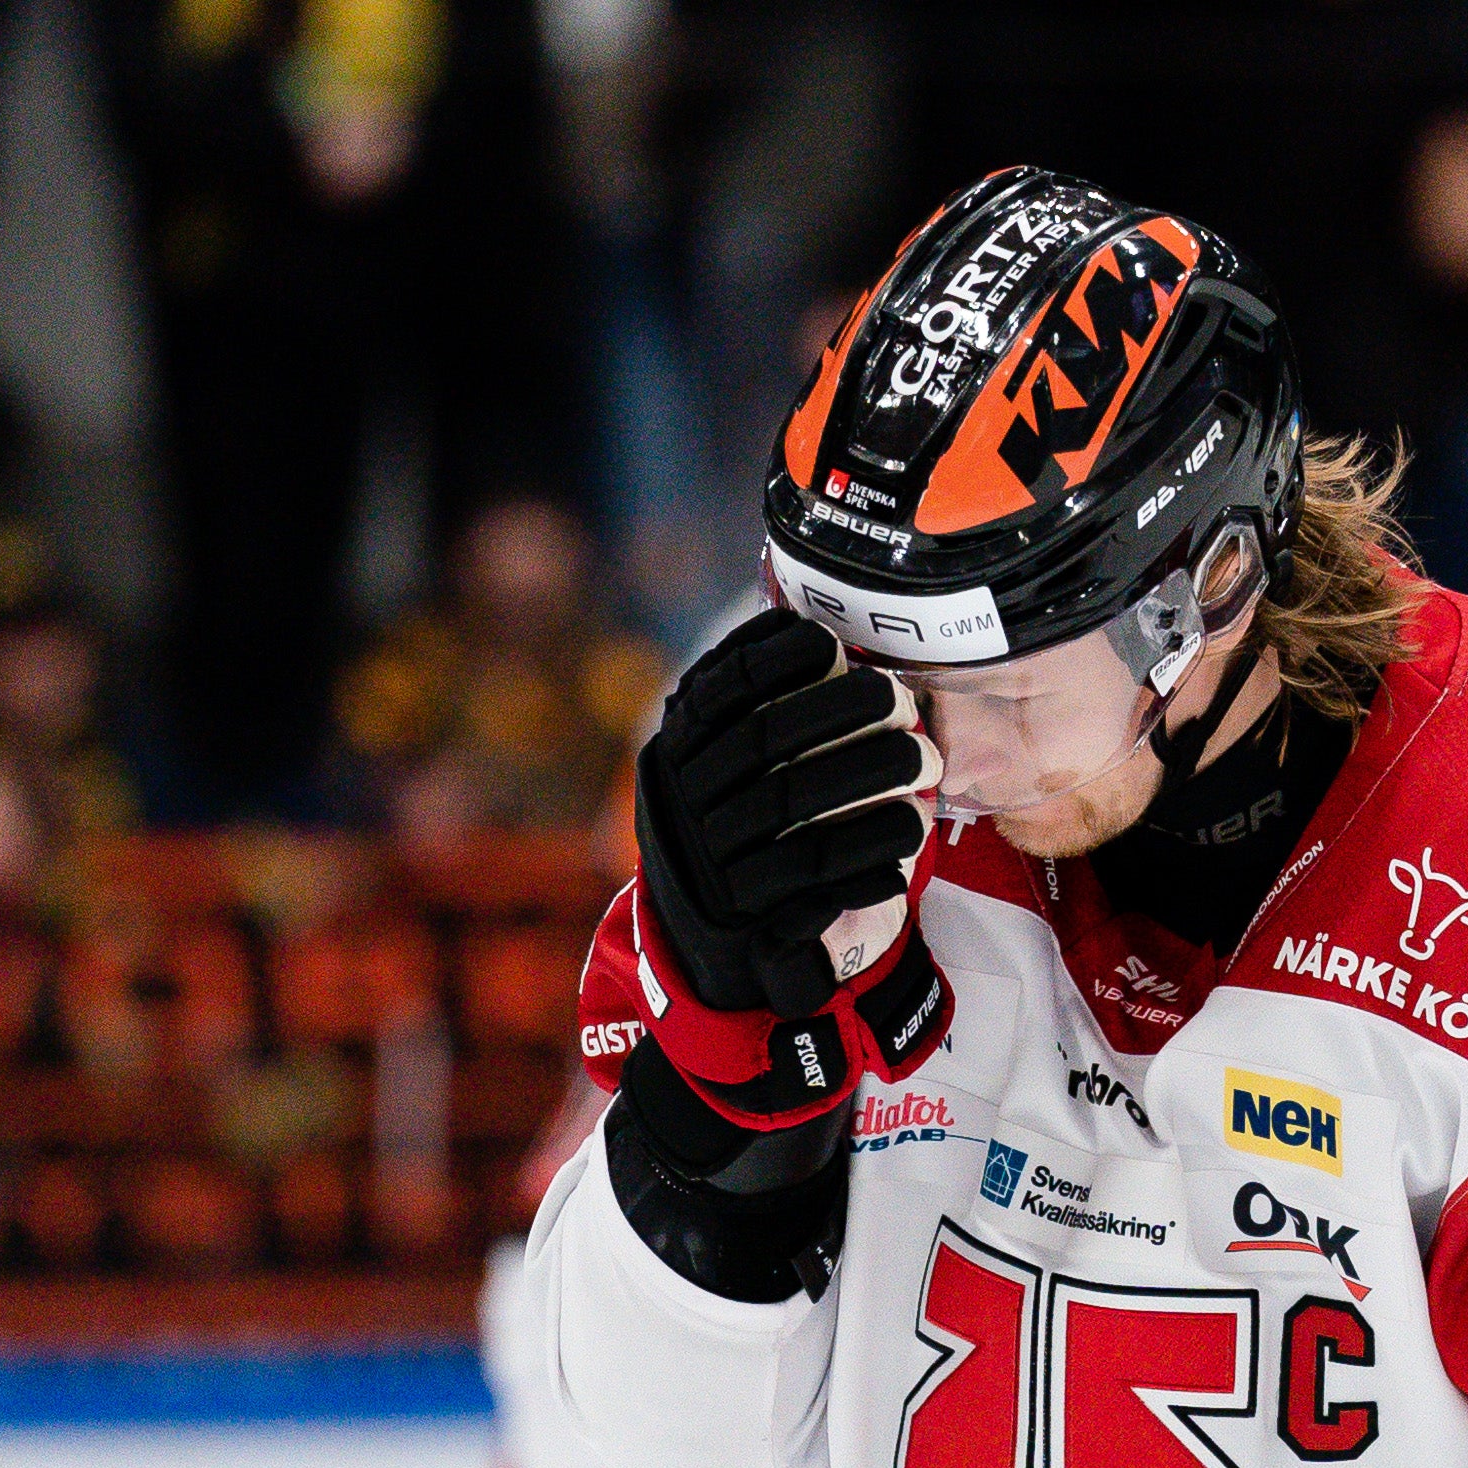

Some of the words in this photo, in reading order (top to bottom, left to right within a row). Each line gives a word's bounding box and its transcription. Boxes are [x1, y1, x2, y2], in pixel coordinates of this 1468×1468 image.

[891, 209, 1053, 395] GÖRTZ
[996, 228, 1191, 501] KTM
[844, 491, 869, 511] SPEL
[848, 481, 897, 509] SVENSKA
[812, 501, 913, 549] BAUER
[939, 612, 995, 638] GWM
[1273, 932, 1413, 1009] NÄRKE
[853, 1092, 954, 1136] diator
[894, 1128, 946, 1146] AB
[1277, 1294, 1379, 1461] C
